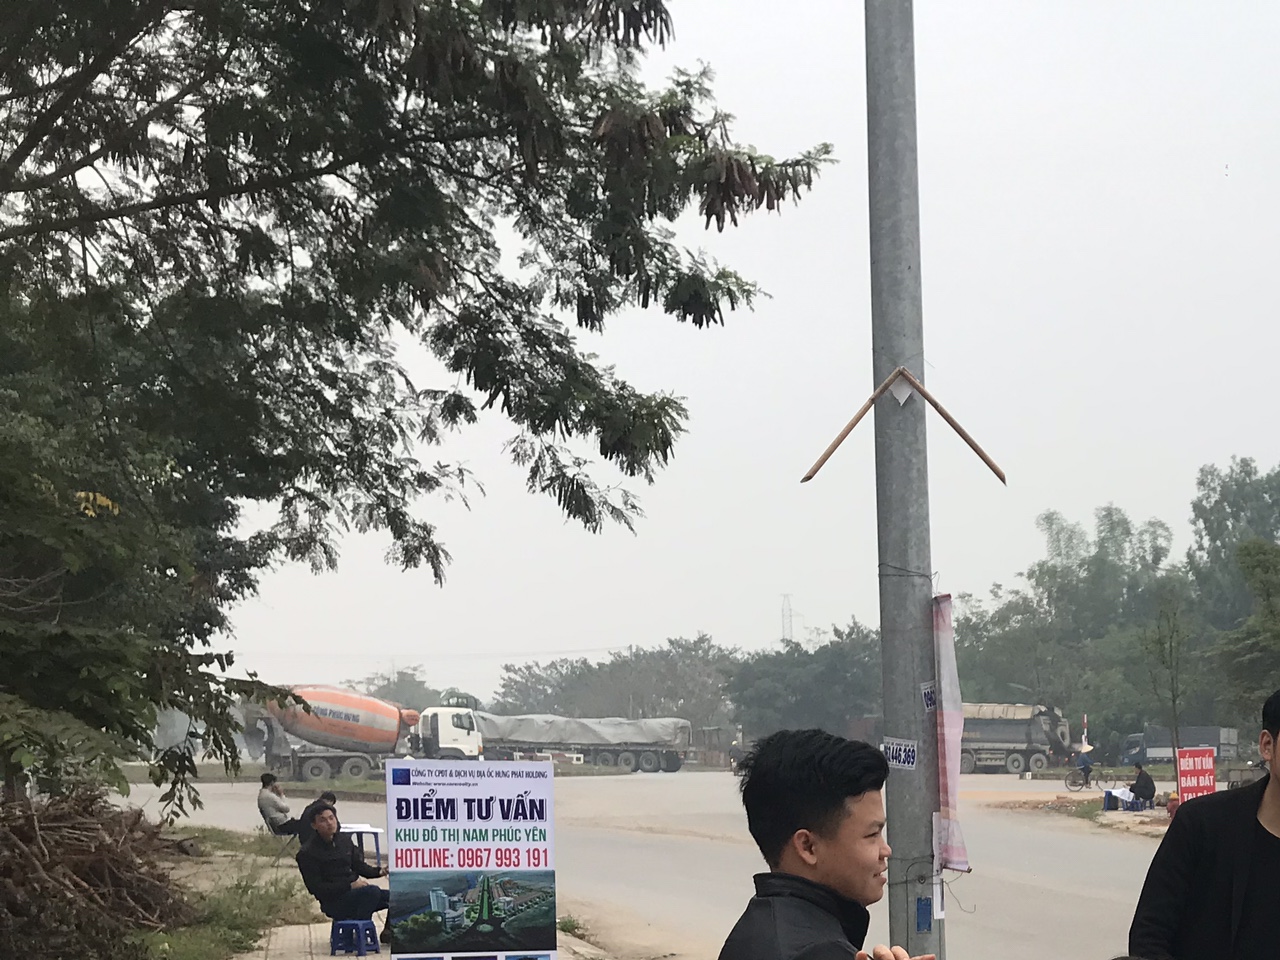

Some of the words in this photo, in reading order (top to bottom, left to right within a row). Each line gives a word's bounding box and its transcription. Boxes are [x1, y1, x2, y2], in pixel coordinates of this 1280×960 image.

[411, 767, 426, 778] CÔNG
[427, 769, 434, 778] TY
[448, 769, 454, 778] &
[454, 769, 468, 779] DỊCH
[468, 769, 476, 779] VỤ
[525, 770, 548, 779] HOLDING
[1181, 774, 1198, 787] BÁN
[1199, 772, 1214, 787] ĐẤT
[395, 789, 458, 822] ĐIỂM
[463, 796, 497, 822] TƯ
[499, 790, 547, 822] VẤN
[395, 828, 419, 842] KHU
[422, 826, 438, 842] ĐÔ
[441, 828, 460, 844] THỊ
[463, 828, 489, 842] NAM
[492, 825, 522, 842] PHÚC
[525, 826, 546, 842] YÊN
[395, 848, 454, 868] HOTLINE:
[457, 848, 492, 868] 0967
[495, 848, 521, 868] 993
[525, 848, 549, 868] 191
